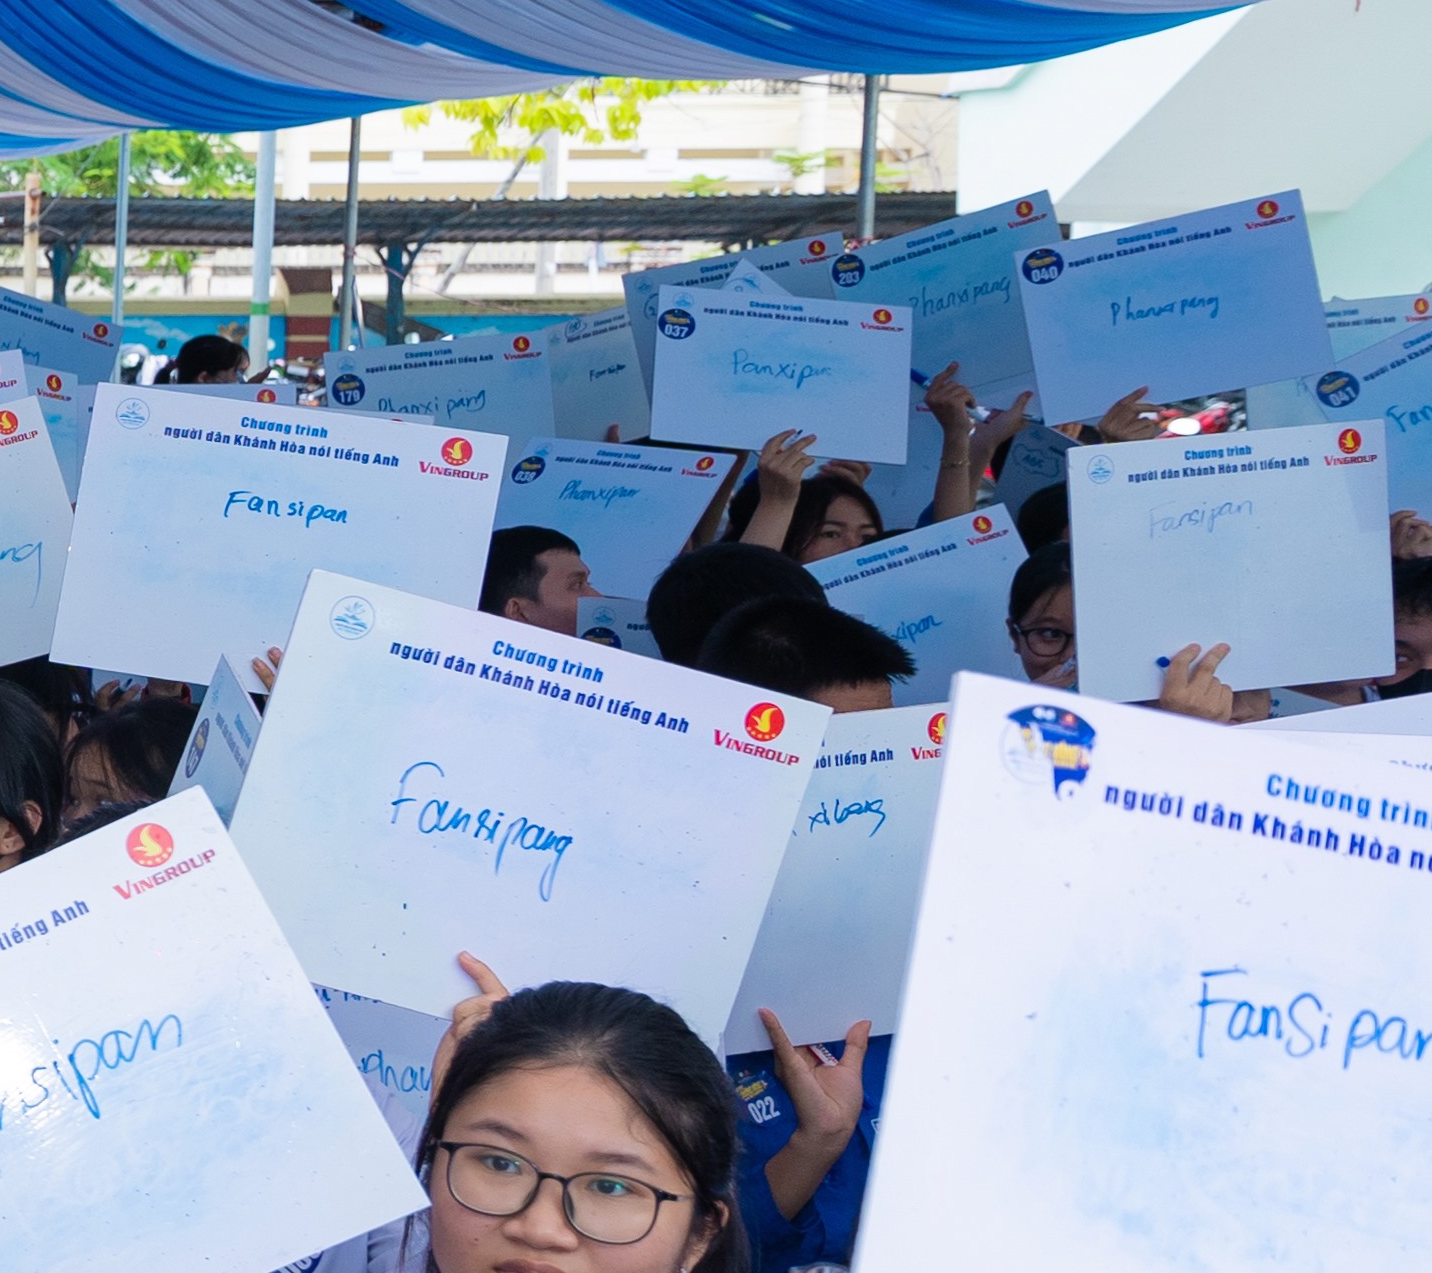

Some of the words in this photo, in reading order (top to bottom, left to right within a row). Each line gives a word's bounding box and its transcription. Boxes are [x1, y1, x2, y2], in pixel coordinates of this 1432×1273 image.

[664, 323, 689, 338] 037
[418, 460, 489, 481] VINGROUP
[492, 639, 558, 672] Chương
[560, 658, 603, 683] trình
[389, 641, 440, 665] người
[442, 654, 476, 675] dân
[478, 663, 534, 691] Khánh
[537, 679, 571, 701] Hòa
[574, 691, 604, 710] nói
[605, 698, 652, 725] tiếng
[654, 711, 689, 734] Anh
[713, 728, 799, 765] VINGROUP
[112, 848, 215, 900] VINGROUP
[747, 1096, 781, 1124] 022
